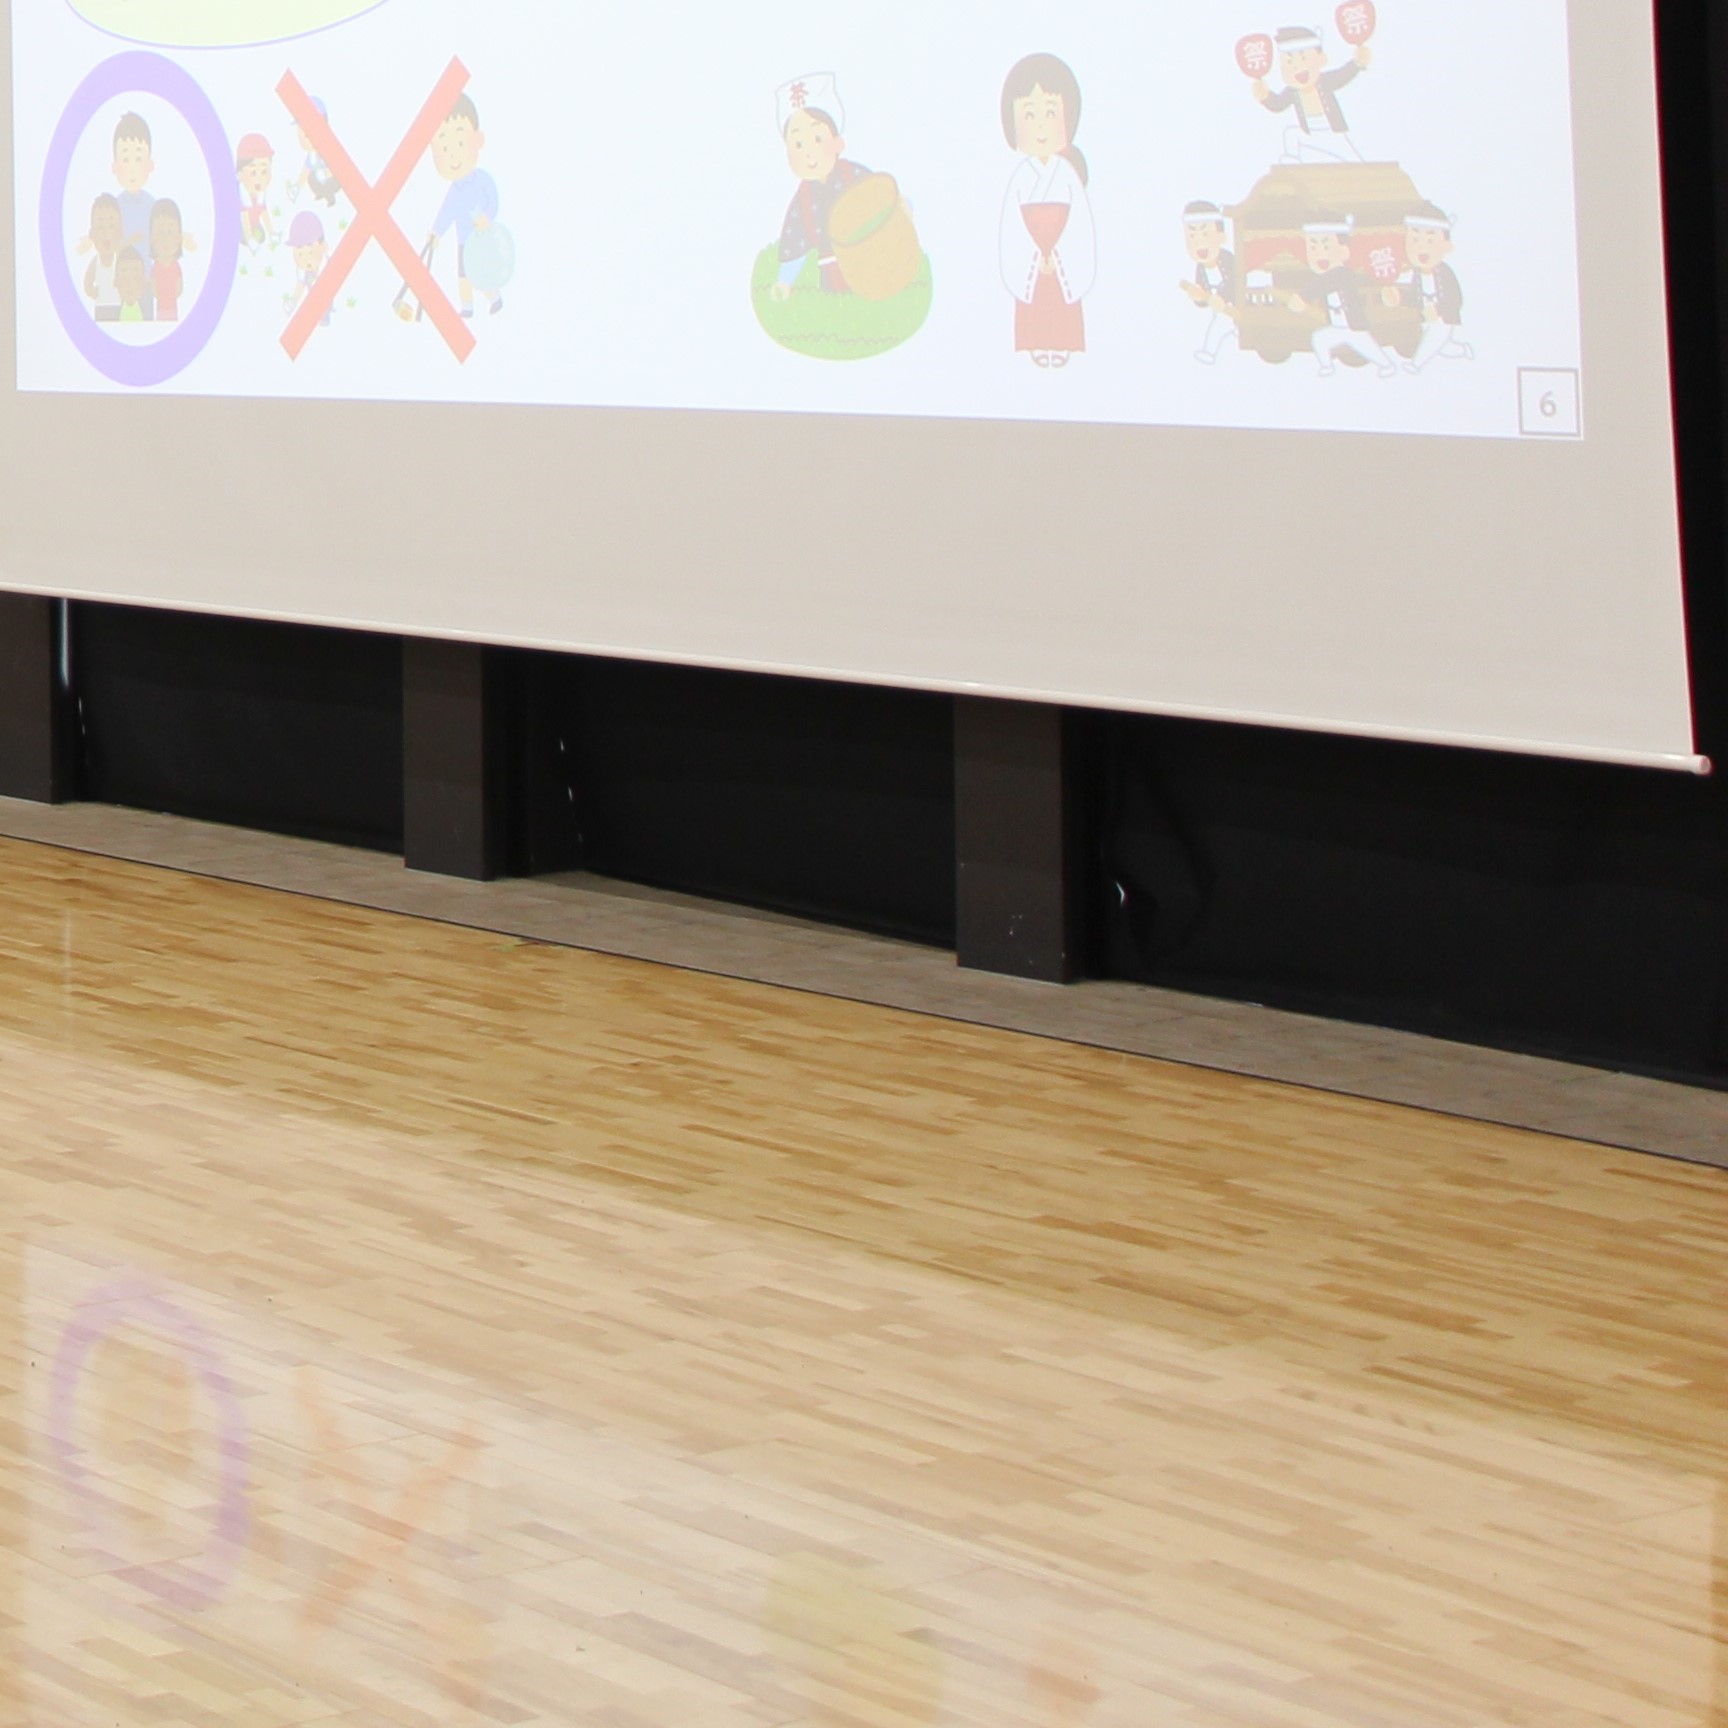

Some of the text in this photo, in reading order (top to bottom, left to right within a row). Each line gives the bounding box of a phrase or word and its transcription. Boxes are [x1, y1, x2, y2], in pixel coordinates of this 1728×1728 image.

[1342, 4, 1368, 35] 祭
[1243, 40, 1268, 70] 祭
[1369, 246, 1397, 278] 祭
[1539, 390, 1557, 418] 6
